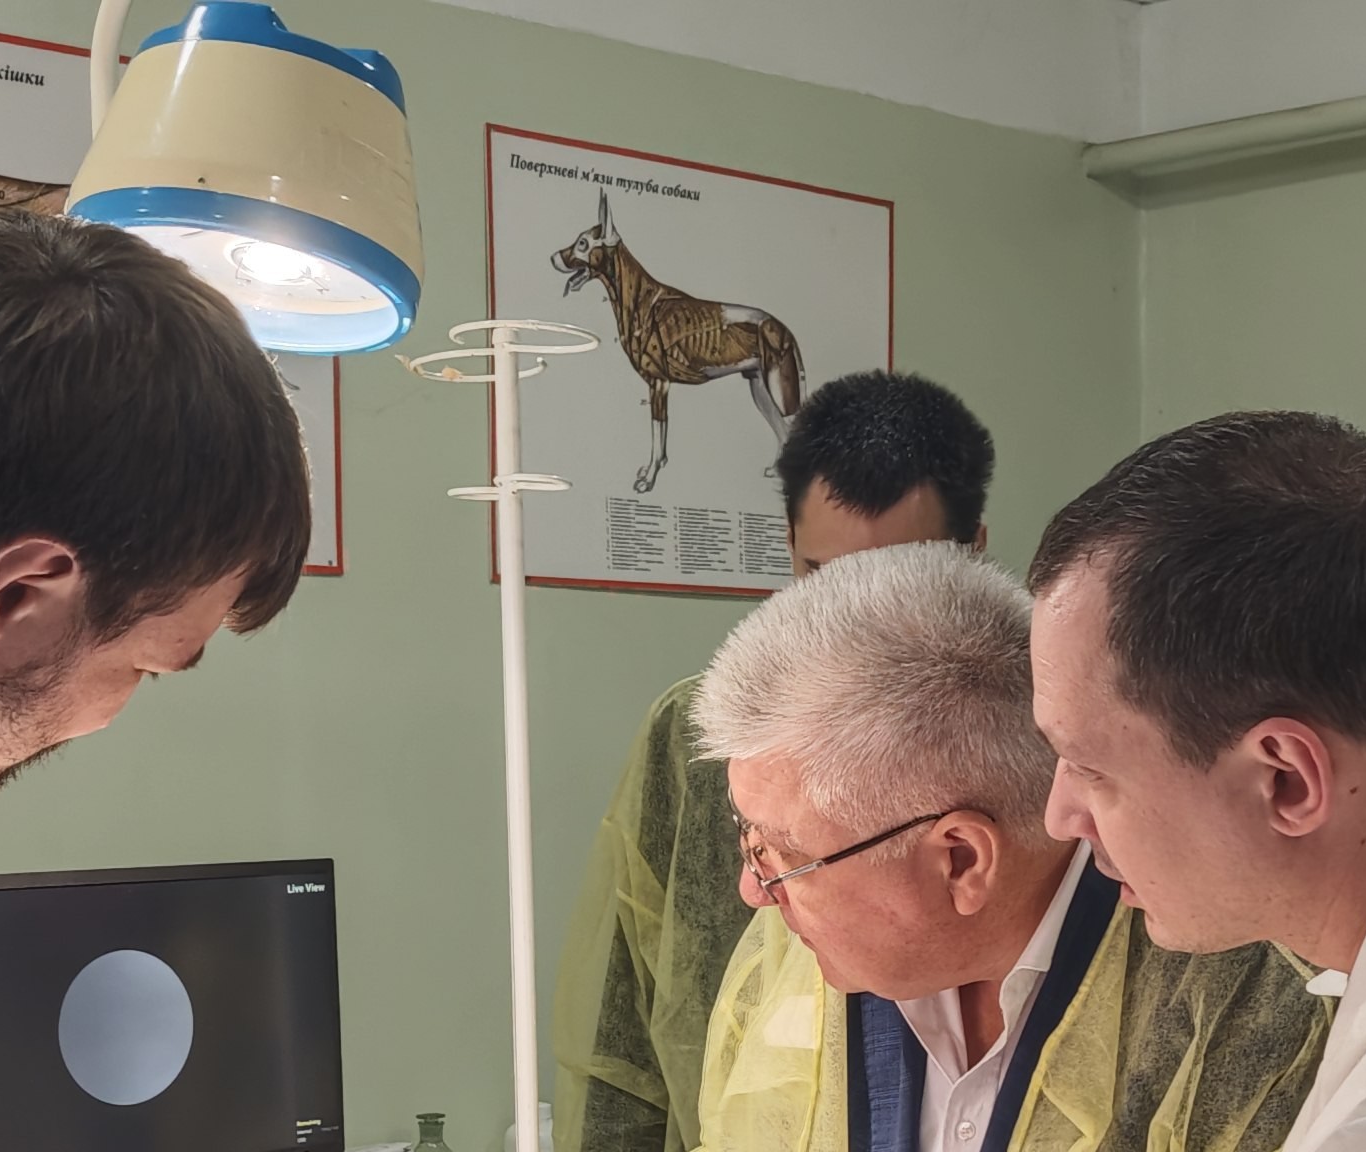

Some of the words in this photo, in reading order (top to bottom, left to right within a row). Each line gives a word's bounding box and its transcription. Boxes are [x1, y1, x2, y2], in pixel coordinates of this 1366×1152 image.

[510, 153, 579, 179] Поверхневі
[580, 168, 613, 186] м'язи
[616, 177, 659, 195] тулуба
[661, 184, 701, 202] собаки
[287, 884, 305, 893] Live
[305, 883, 325, 892] View
